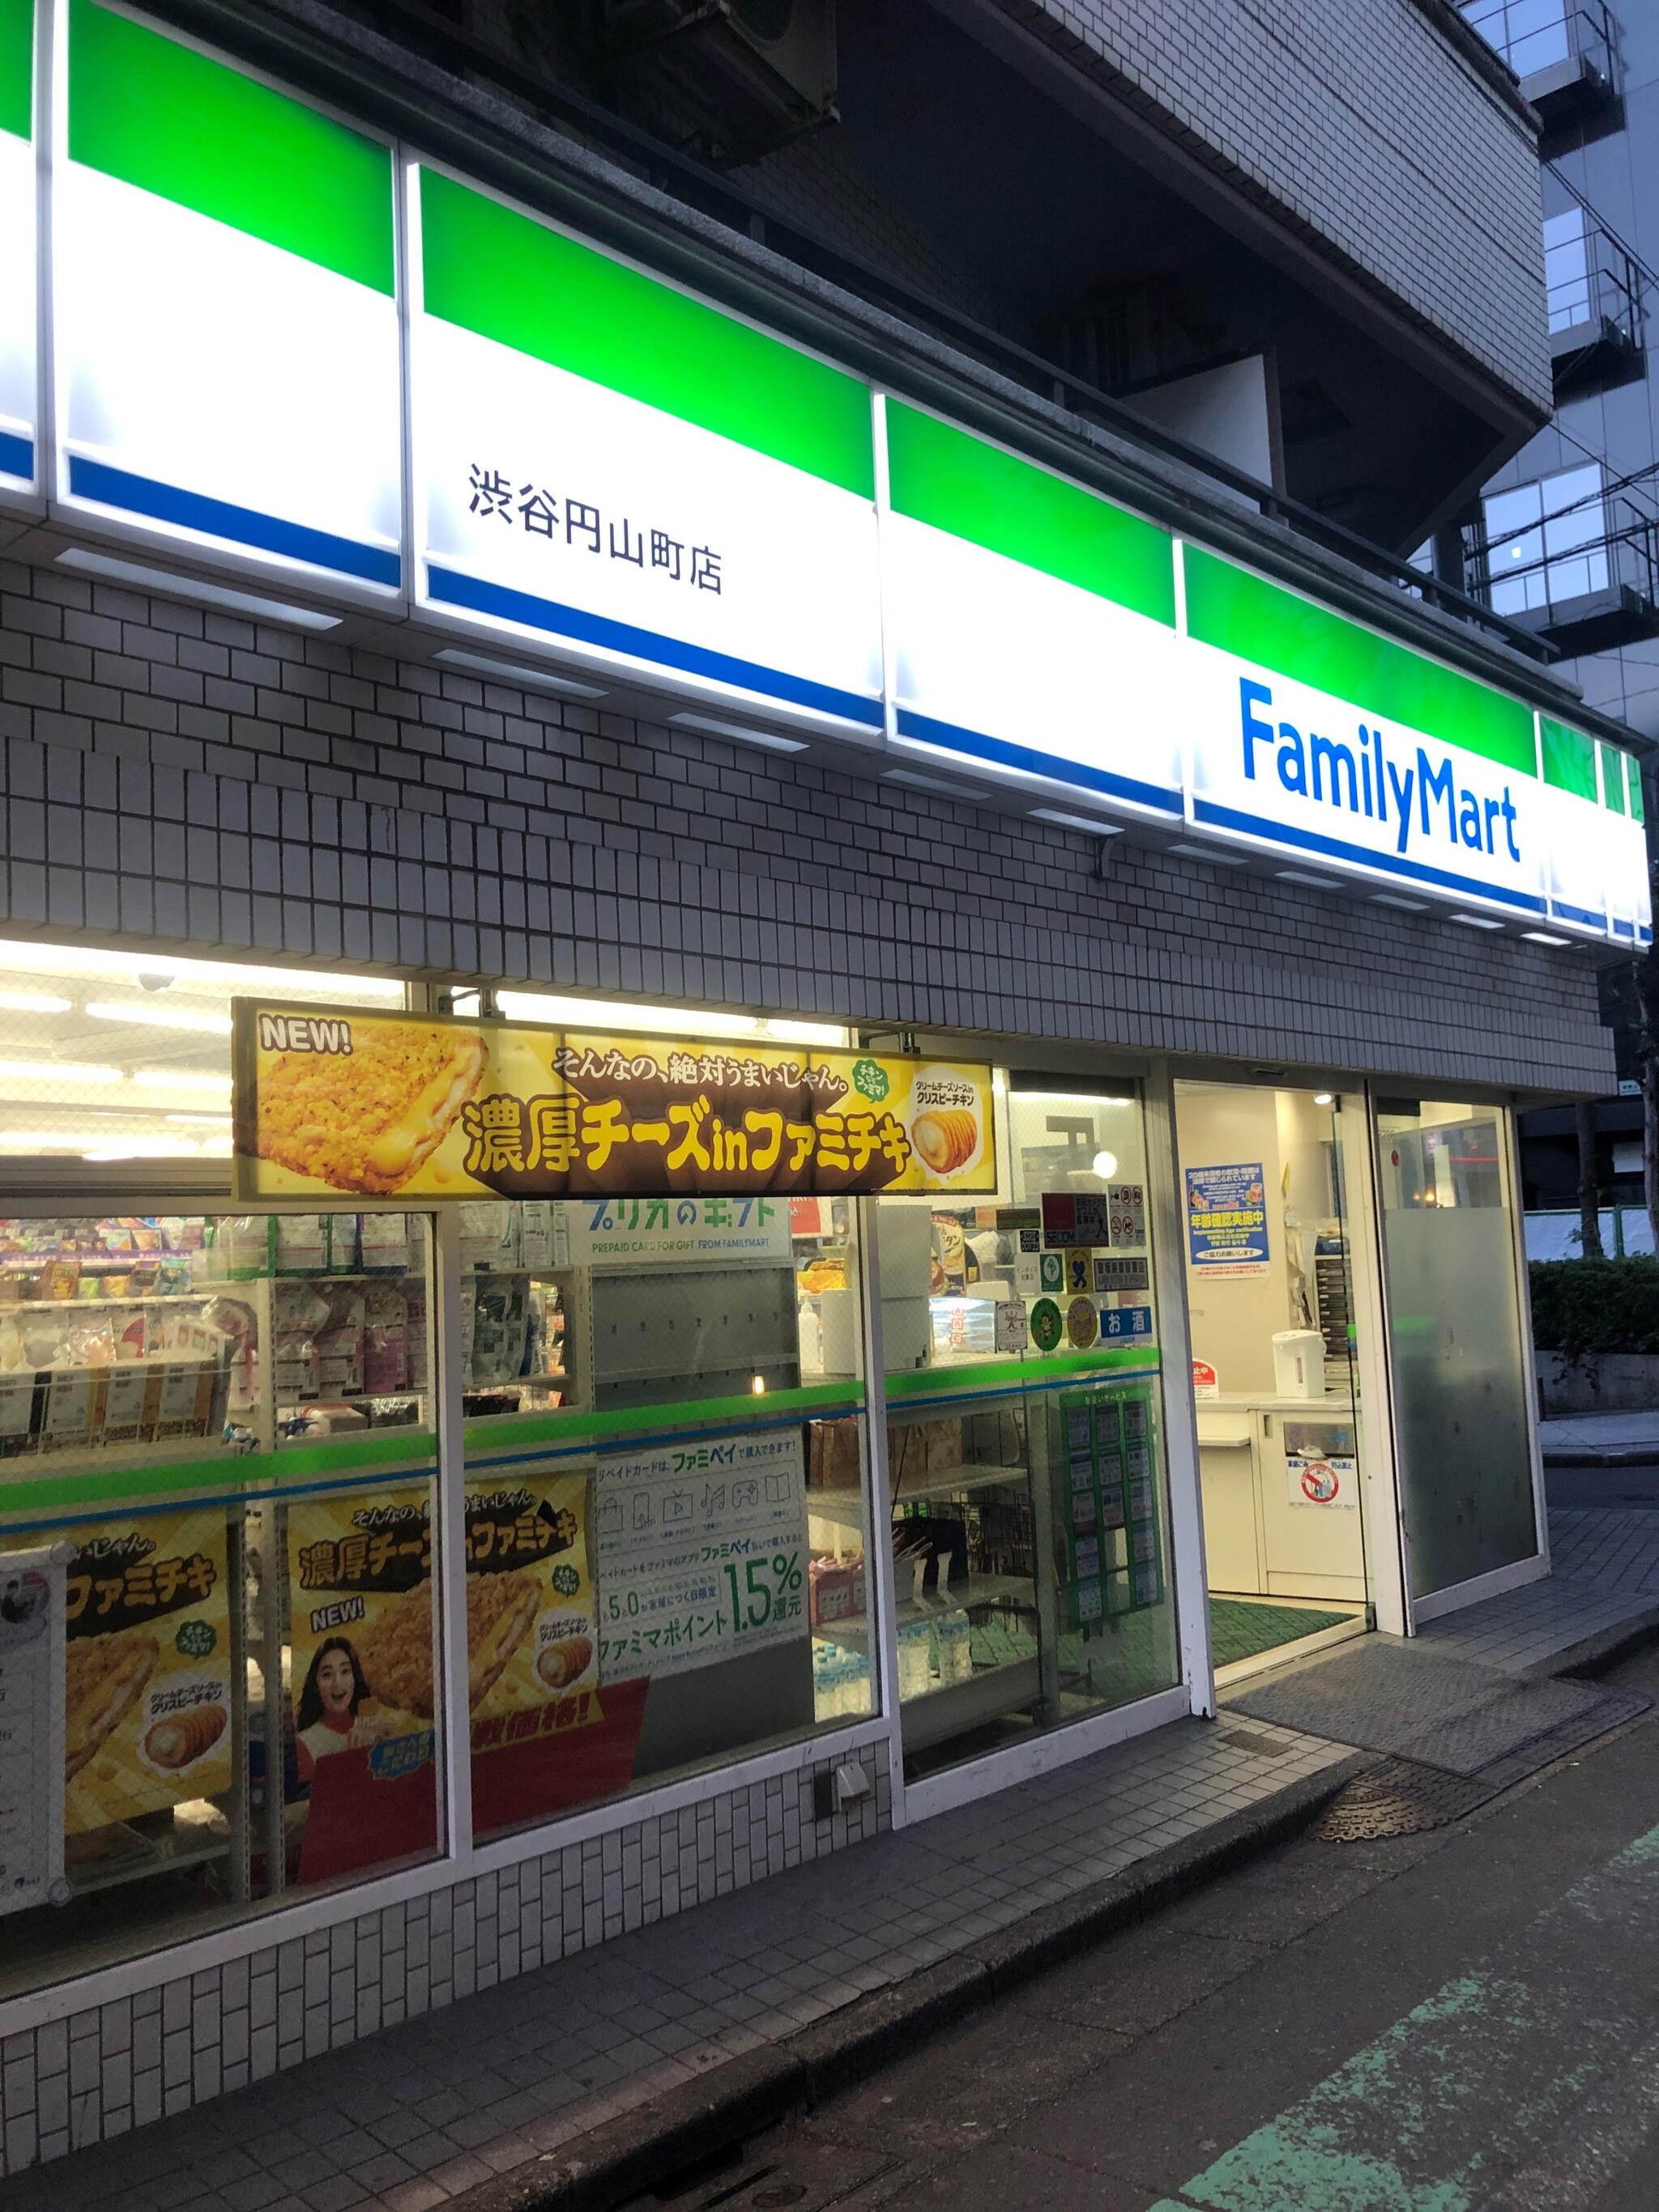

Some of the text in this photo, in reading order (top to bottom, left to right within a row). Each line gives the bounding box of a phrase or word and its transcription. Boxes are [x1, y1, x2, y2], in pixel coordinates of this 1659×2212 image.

[468, 462, 722, 596] 渋谷円山町店
[1239, 676, 1521, 863] FamilyMart
[260, 1016, 352, 1055] NEW!
[553, 1049, 848, 1093] そんなの、絶対うまいじゃん。
[859, 1063, 884, 1080] チキン
[916, 1093, 975, 1106] クリスピーチキン
[463, 1093, 911, 1173] 濃厚チーズinファミチキ
[1191, 1209, 1264, 1228] 年齢確認実施中
[592, 1241, 629, 1254] PREPAID
[658, 1241, 676, 1251] FOR
[676, 1240, 694, 1251] GIFT
[698, 1239, 721, 1250] FROM
[722, 1238, 770, 1249] FAMILYMART
[1046, 1230, 1076, 1244] SECOM
[1108, 1311, 1145, 1334] お酒
[723, 1550, 803, 1633] 1.5%
[313, 1596, 365, 1632] NEW!
